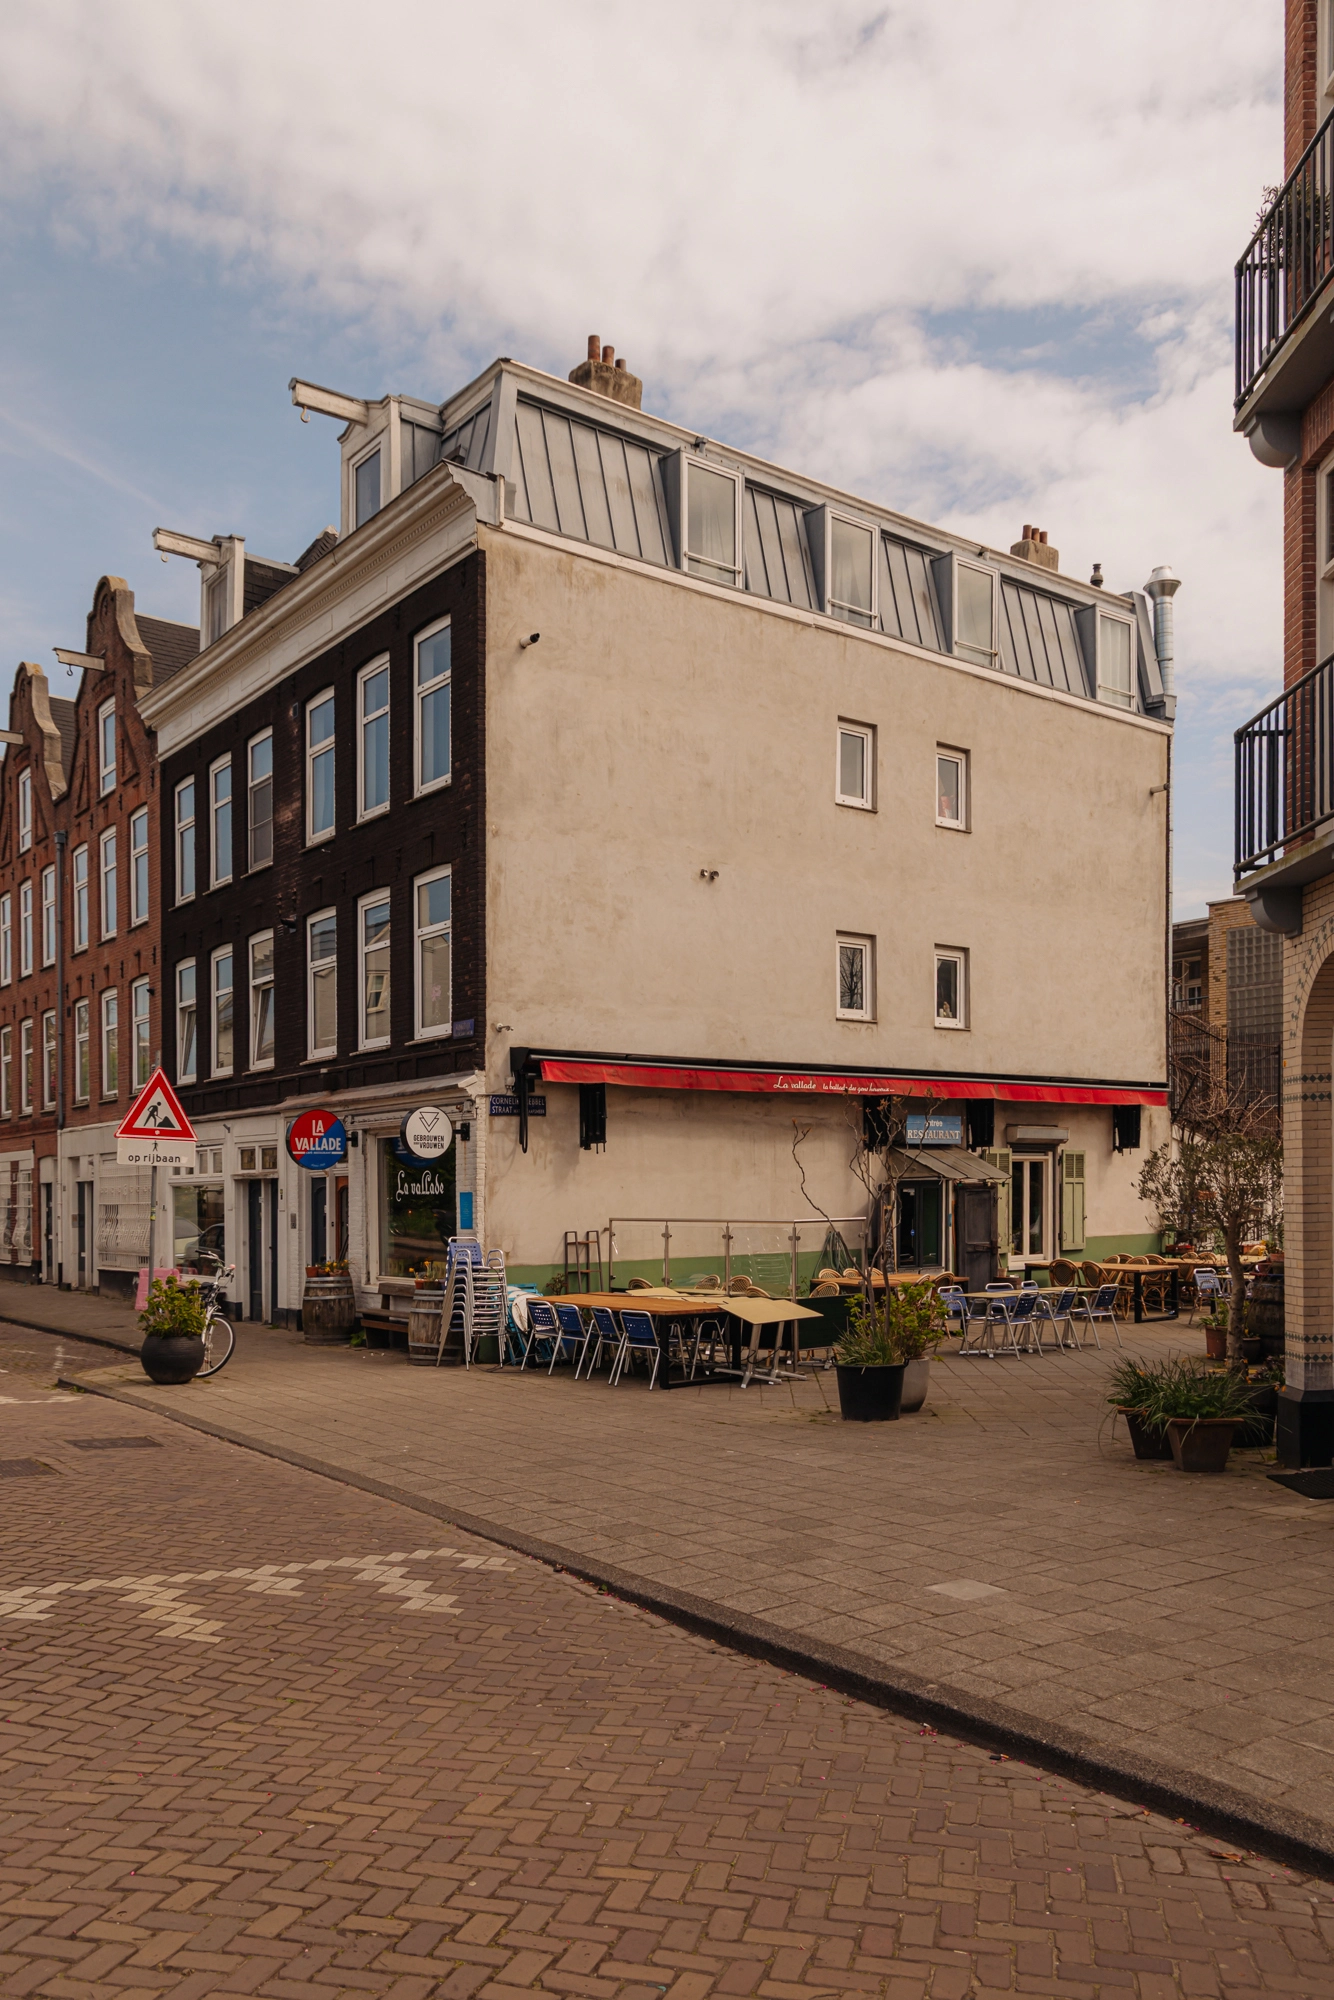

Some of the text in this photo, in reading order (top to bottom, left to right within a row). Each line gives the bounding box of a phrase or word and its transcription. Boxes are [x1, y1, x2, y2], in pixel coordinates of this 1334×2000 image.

[773, 1075, 816, 1089] La vallade
[491, 1106, 513, 1114] STRAAT
[312, 1119, 325, 1136] LA
[413, 1134, 445, 1142] GEBROUWEN
[907, 1129, 960, 1140] RESTAURANT
[295, 1137, 342, 1151] VALLADE
[419, 1142, 445, 1150] VROUWEN
[128, 1153, 181, 1165] op rijbaan
[395, 1169, 409, 1202] La
